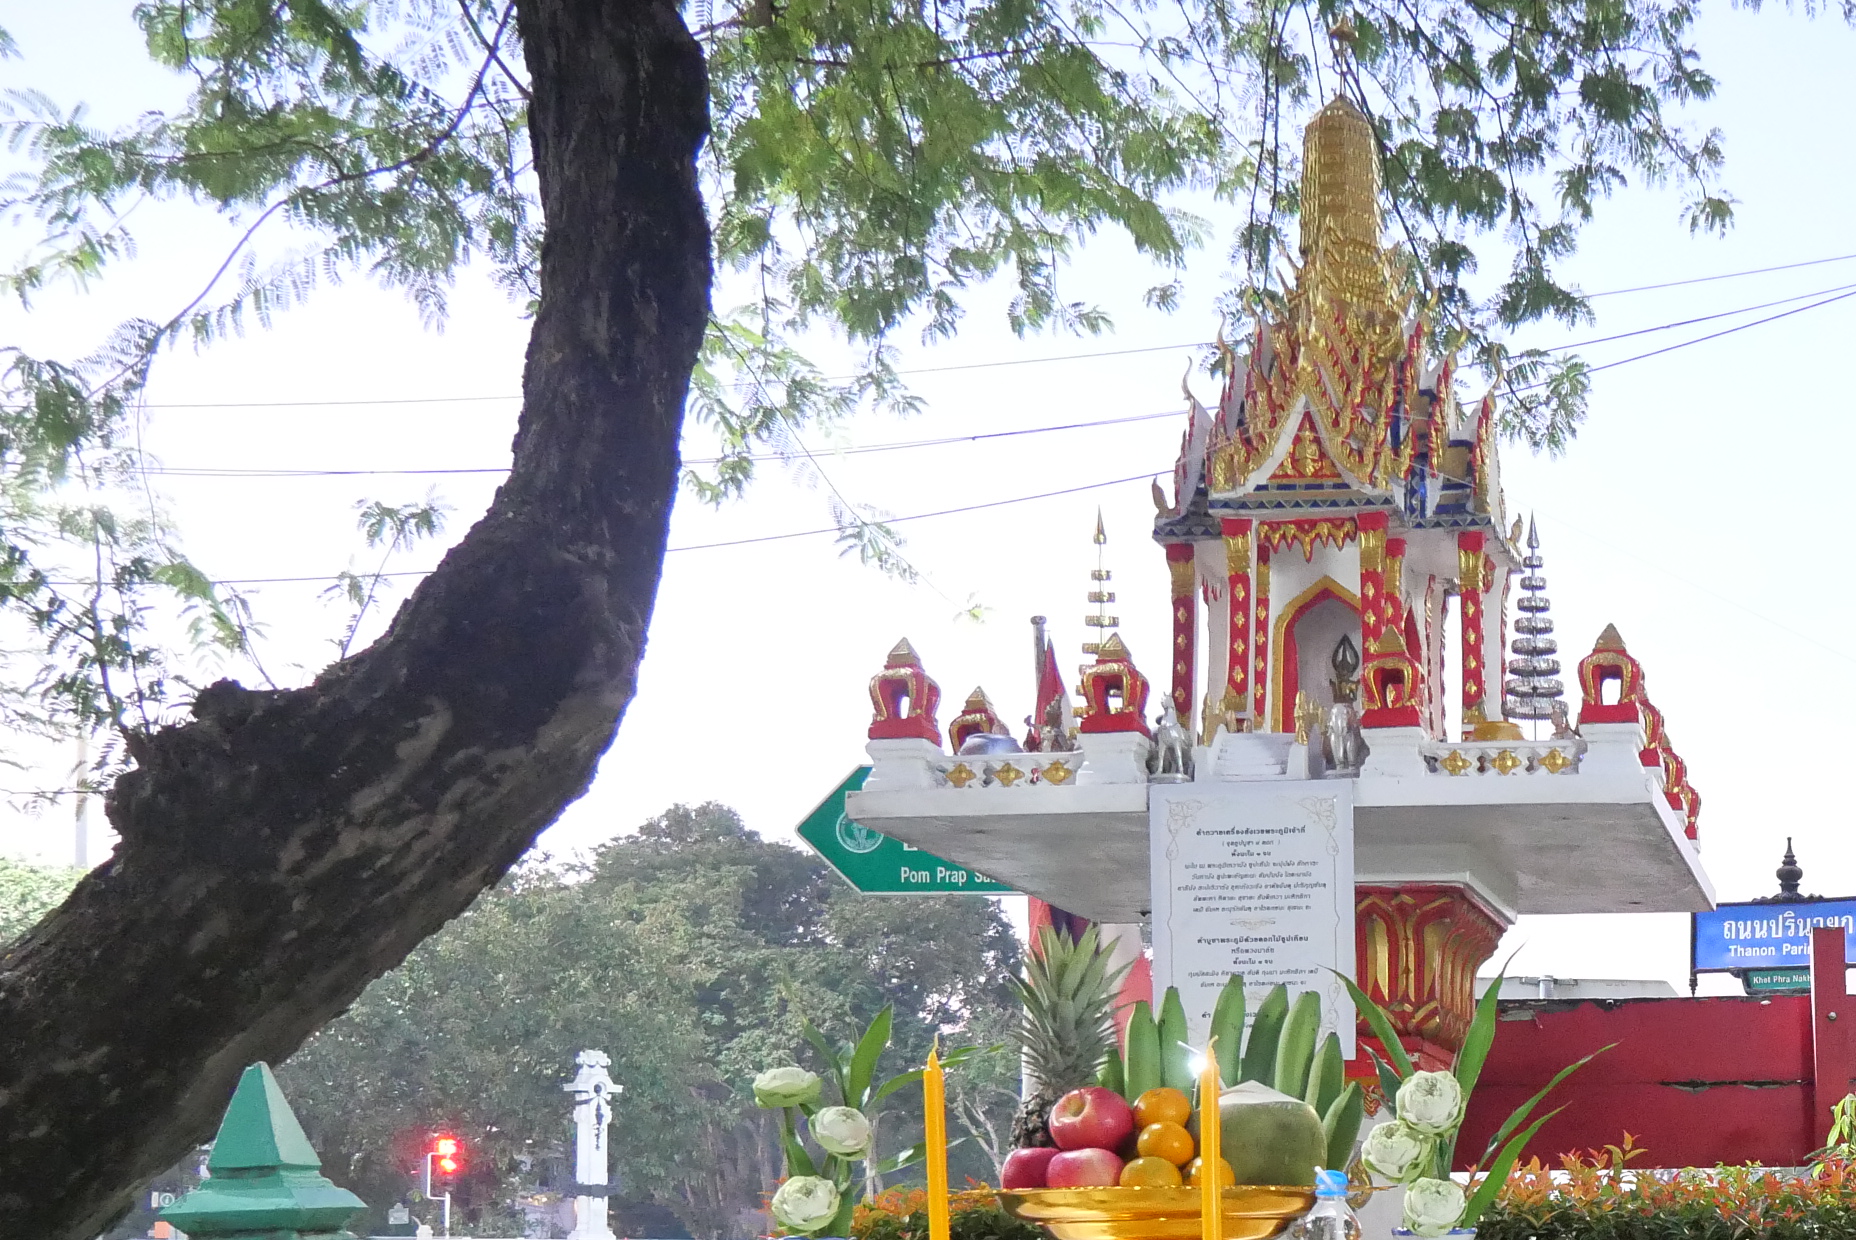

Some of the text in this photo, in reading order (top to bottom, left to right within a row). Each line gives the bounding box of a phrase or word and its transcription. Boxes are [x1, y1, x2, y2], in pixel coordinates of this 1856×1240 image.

[901, 867, 930, 883] Pom
[937, 867, 967, 887] Prap
[1729, 943, 1811, 957] Thanon Pari
[1773, 975, 1791, 983] Phra
